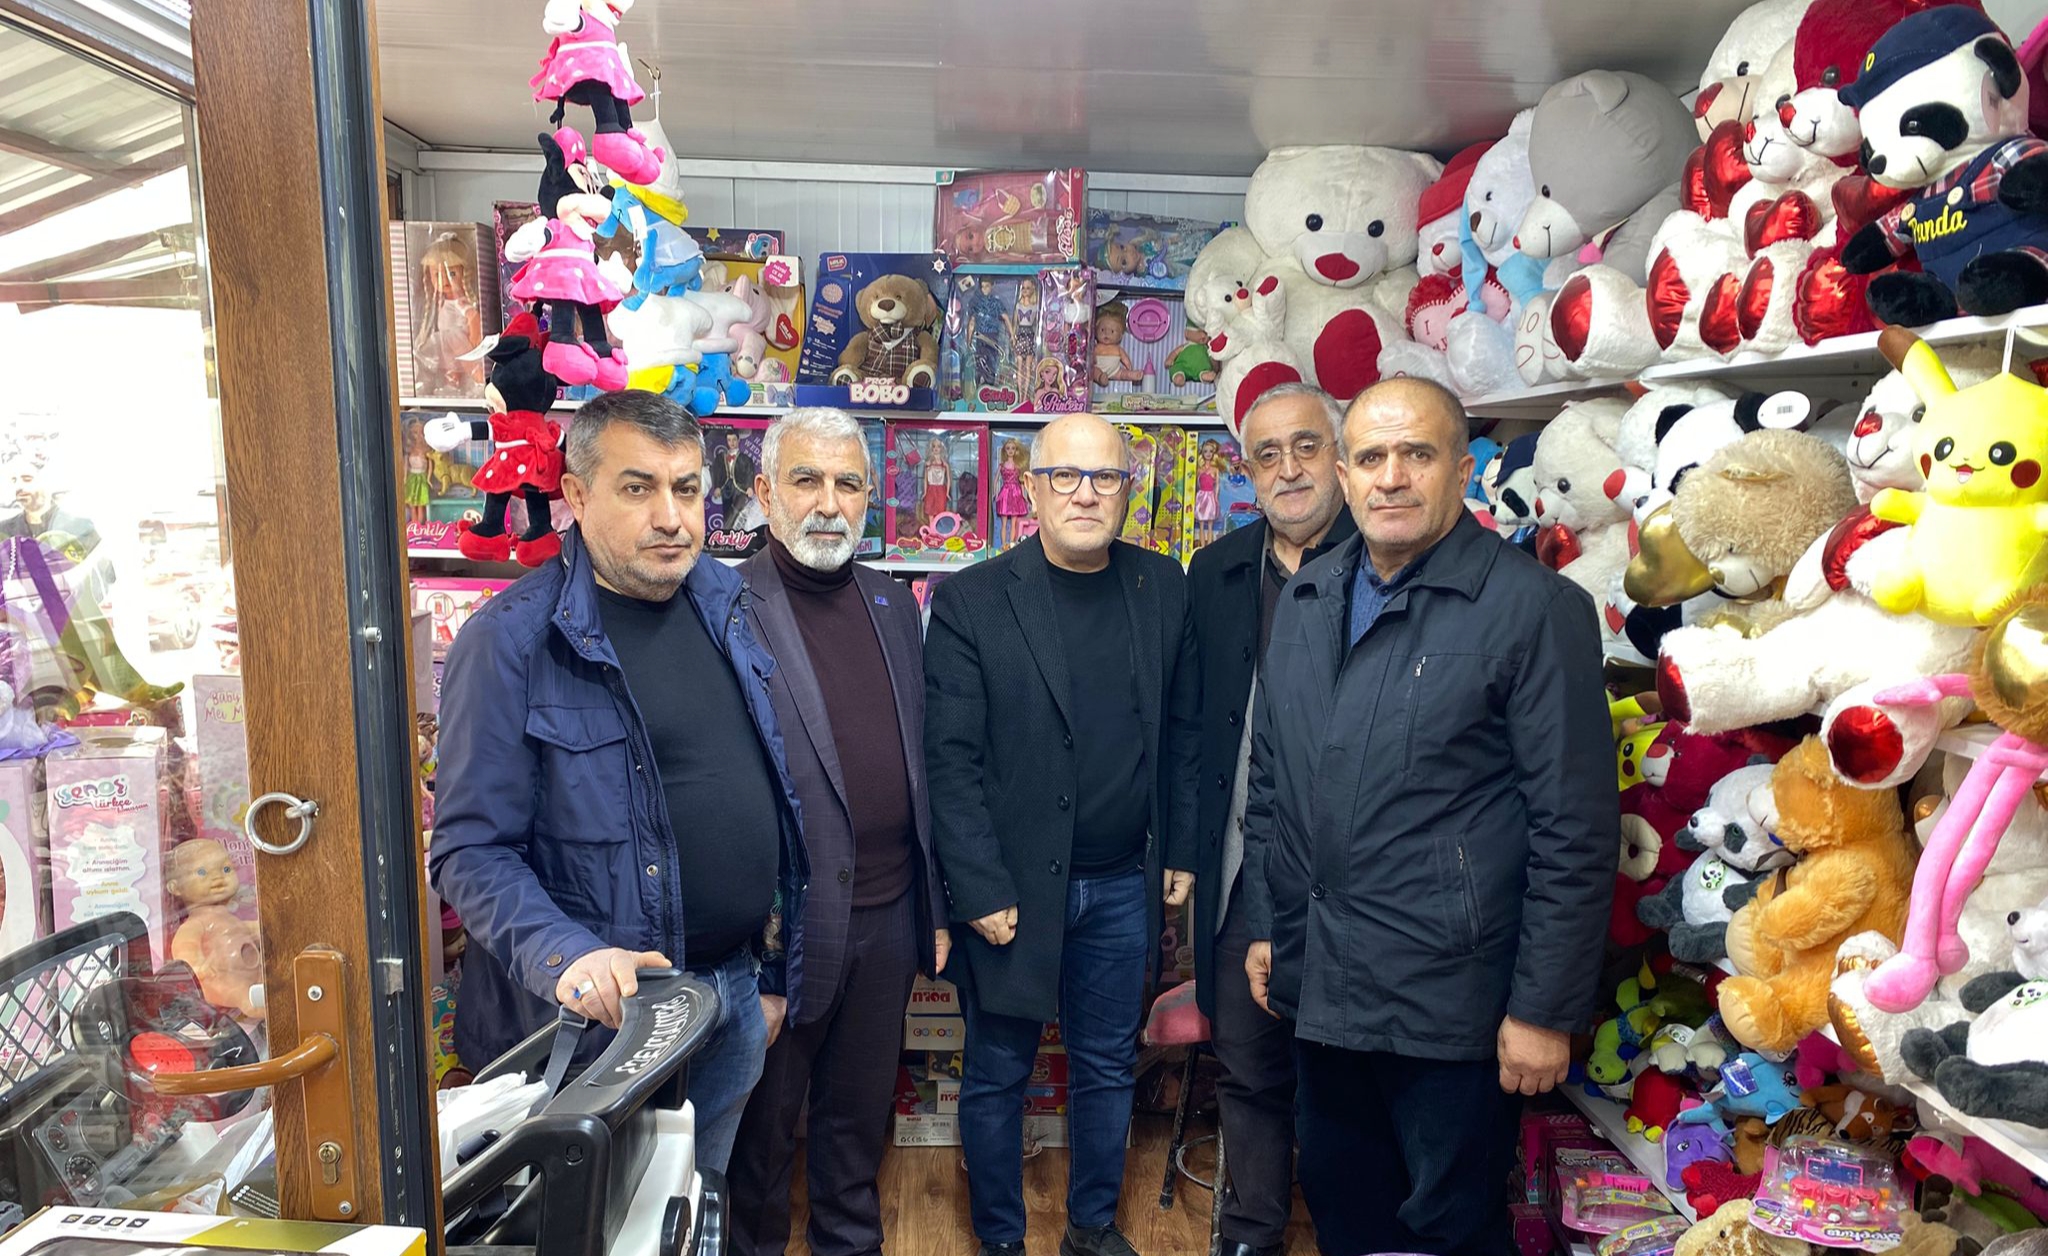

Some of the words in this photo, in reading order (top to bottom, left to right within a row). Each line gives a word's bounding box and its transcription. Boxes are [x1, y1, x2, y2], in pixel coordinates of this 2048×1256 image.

[1908, 205, 1968, 244] Panda
[850, 384, 910, 404] BOBO
[211, 691, 241, 706] Baby
